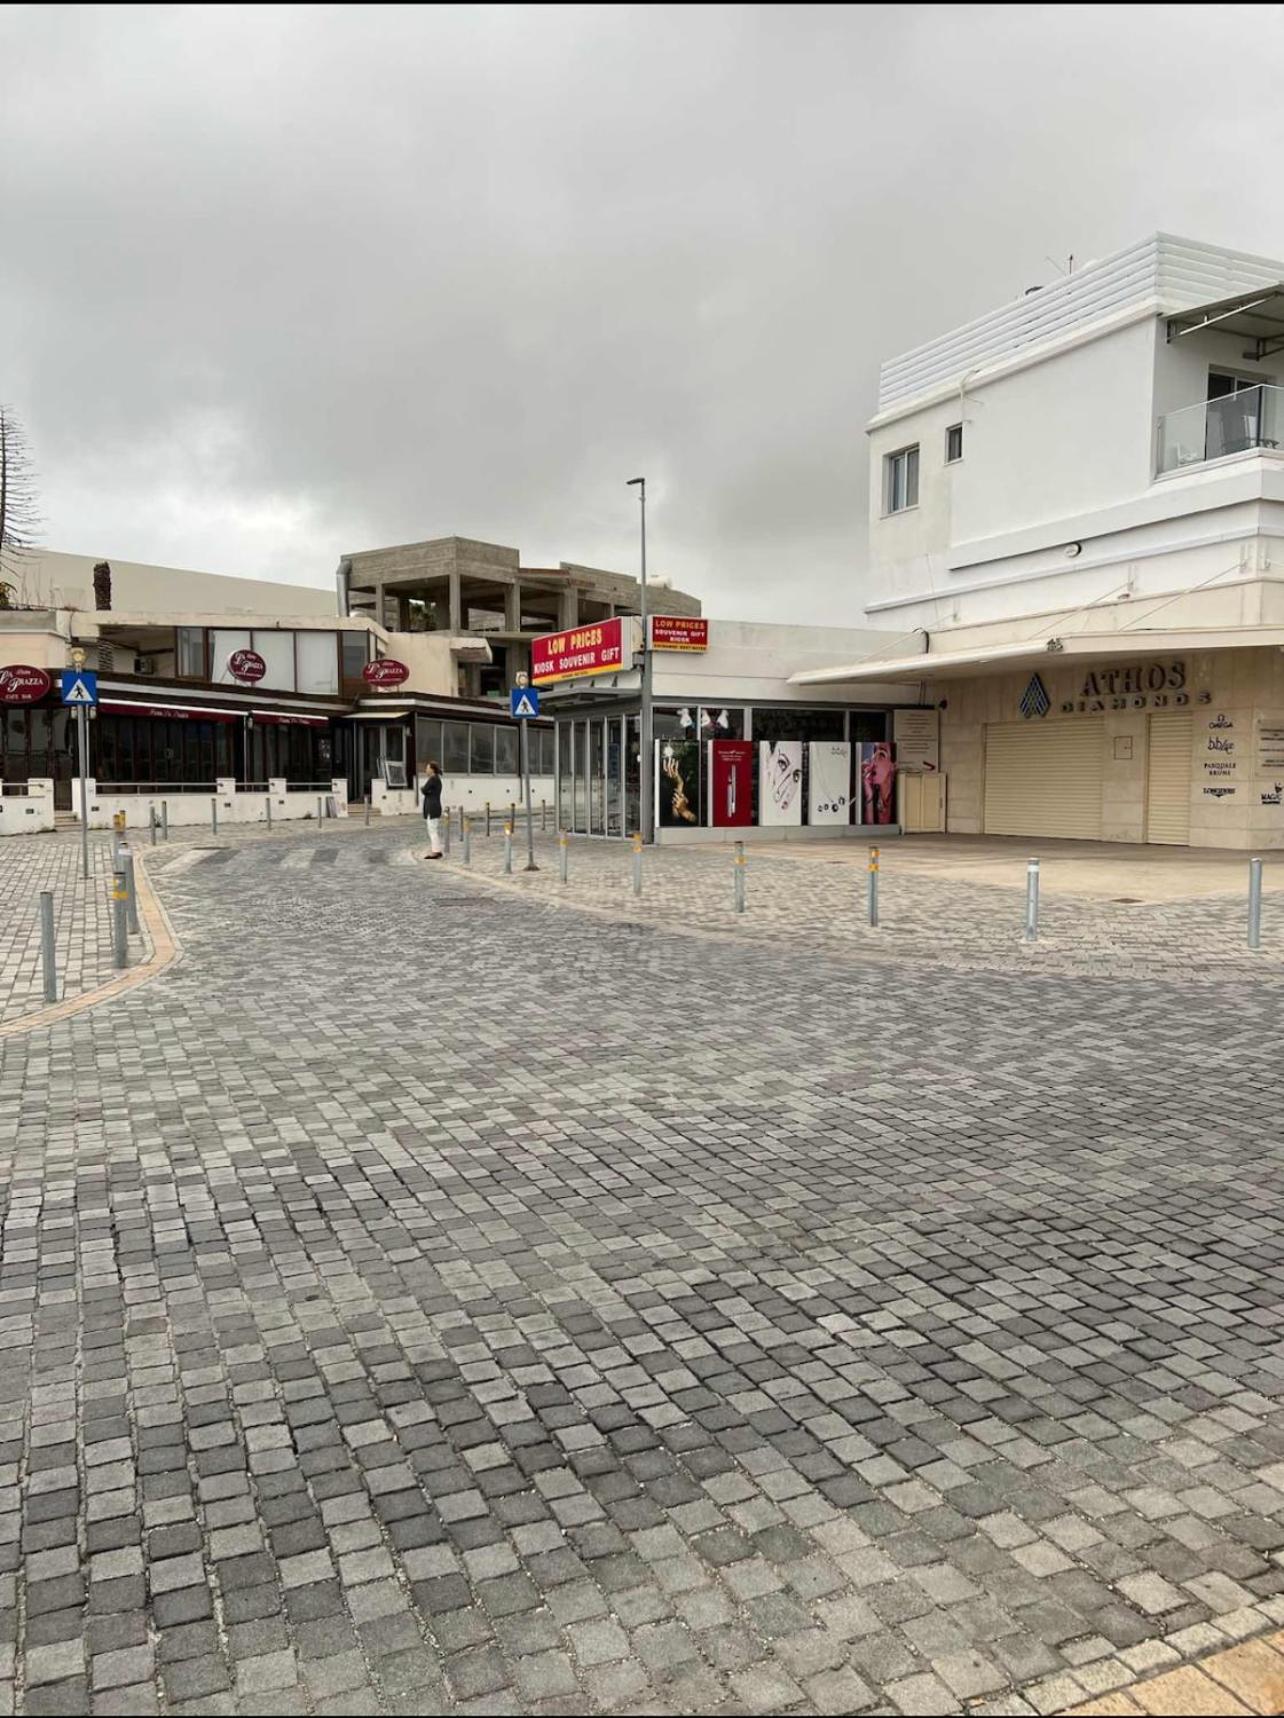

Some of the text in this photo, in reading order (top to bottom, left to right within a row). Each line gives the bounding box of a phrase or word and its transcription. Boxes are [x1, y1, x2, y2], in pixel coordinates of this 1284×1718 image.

[655, 620, 705, 630] LOW PRICES
[655, 629, 687, 637] SOUVENIR
[547, 627, 603, 655] LOW PRICES
[534, 660, 554, 675] KIOSK
[559, 651, 596, 670] SOUVENIR
[601, 646, 620, 662] GIFT
[1080, 661, 1187, 697] ATHOS
[1060, 691, 1213, 713] DIAMONDS
